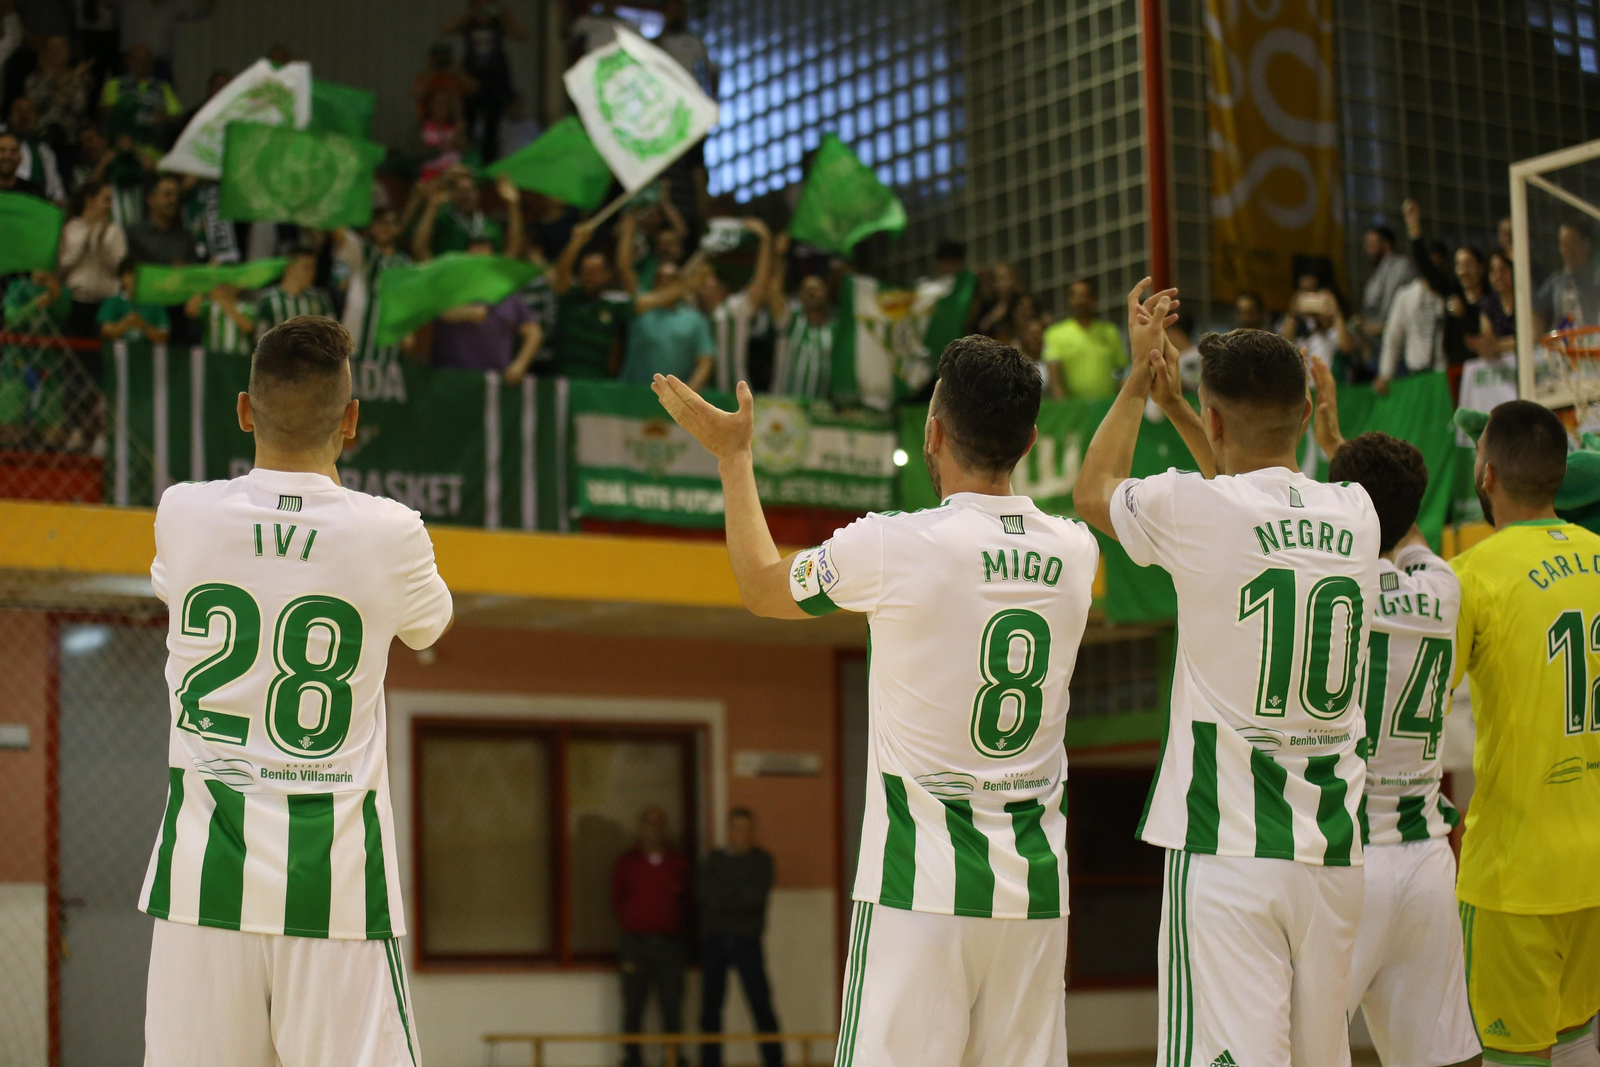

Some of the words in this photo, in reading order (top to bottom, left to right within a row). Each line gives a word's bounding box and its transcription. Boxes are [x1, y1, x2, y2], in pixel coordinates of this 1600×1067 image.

[253, 523, 318, 562] IVI
[1253, 519, 1354, 558] NEGRO
[981, 549, 1063, 588] MIGO
[1235, 567, 1364, 721] 10
[174, 580, 364, 760] 28
[968, 606, 1052, 761] 8
[1357, 630, 1453, 761] 14
[1290, 735, 1317, 746] Benito
[260, 767, 297, 781] Benito
[982, 780, 1011, 791] Benito
